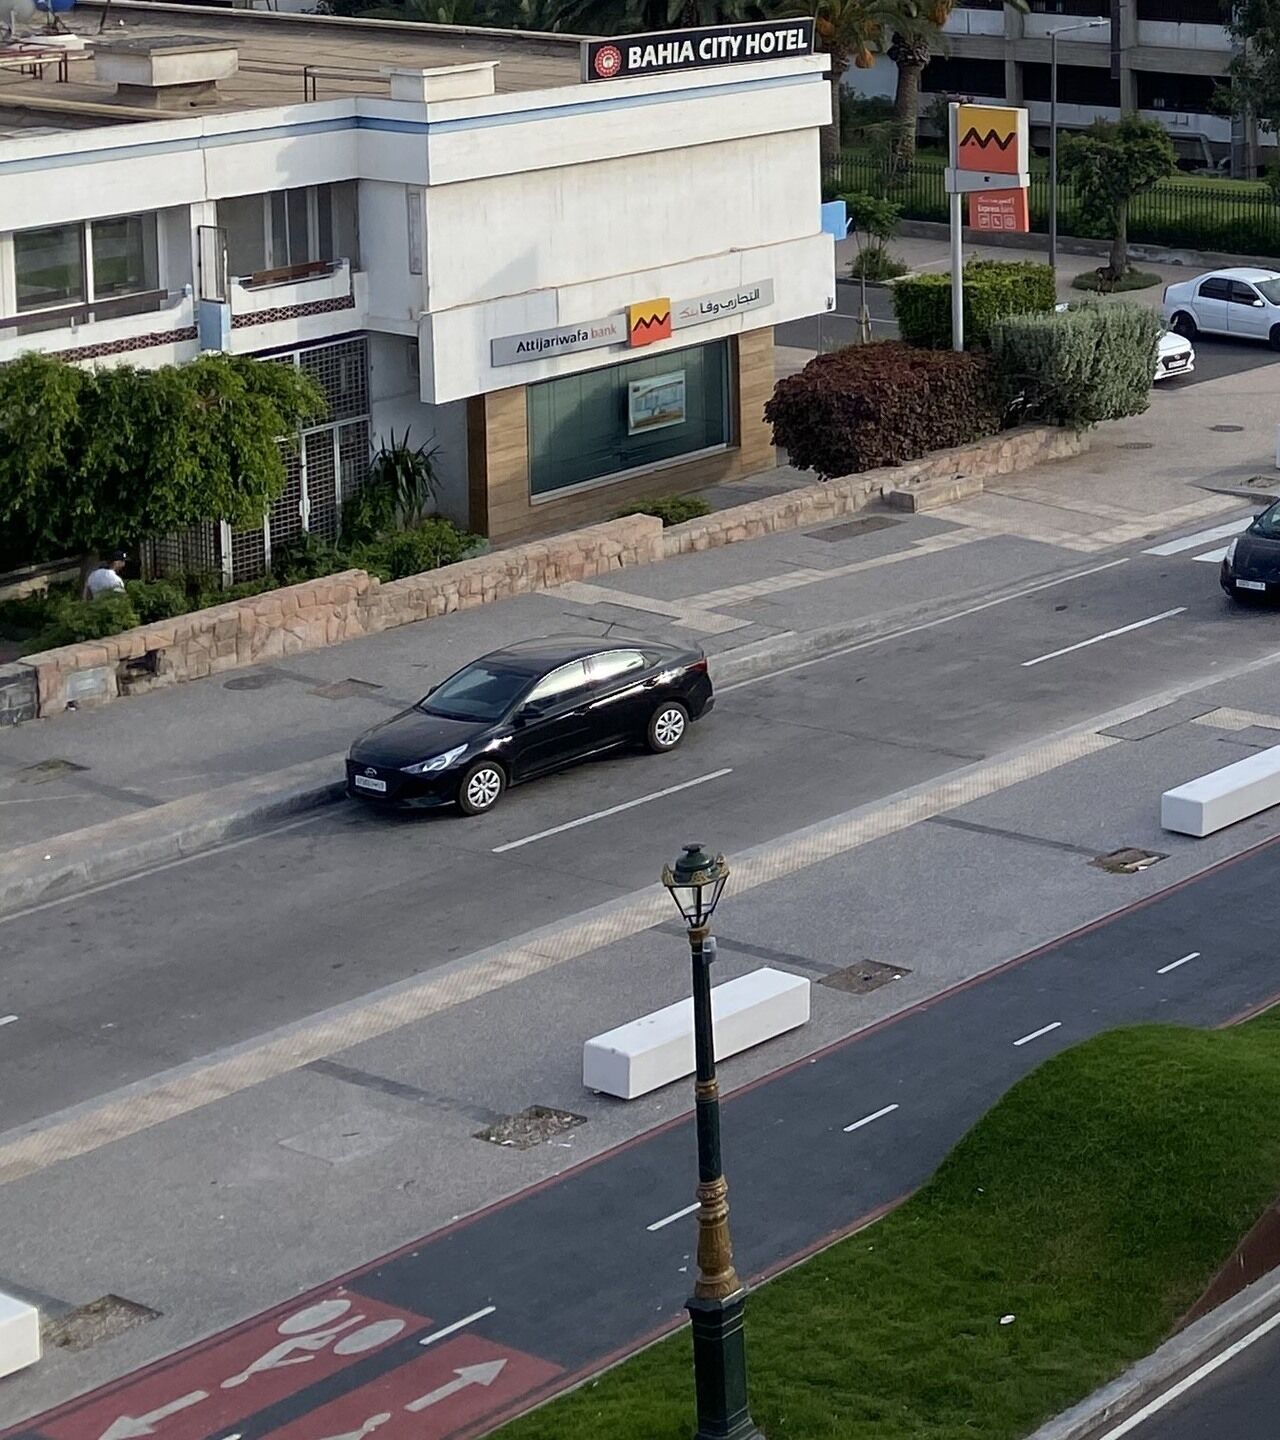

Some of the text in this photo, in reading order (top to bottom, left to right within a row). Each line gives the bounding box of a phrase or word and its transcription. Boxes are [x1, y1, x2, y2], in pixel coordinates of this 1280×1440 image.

[628, 28, 808, 69] BAHIA CITY HOTEL
[516, 324, 616, 353] Attijariwafa bank
